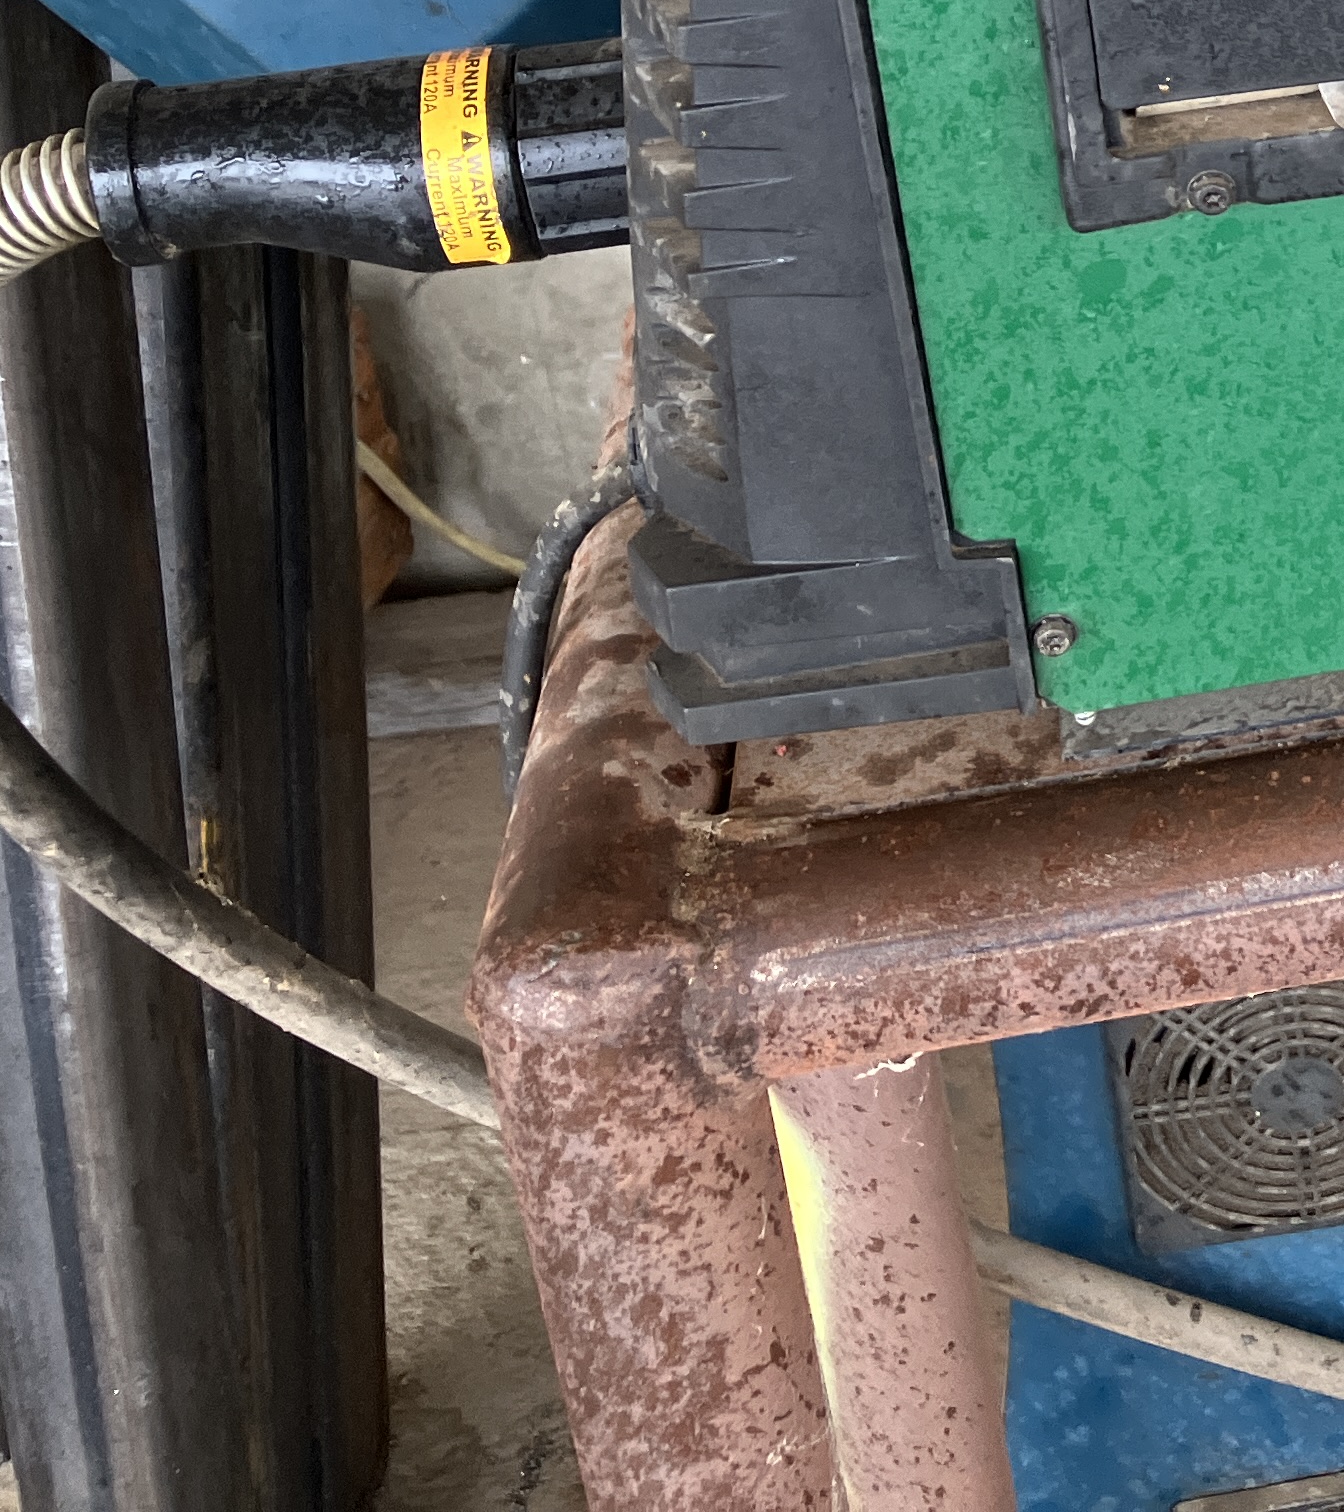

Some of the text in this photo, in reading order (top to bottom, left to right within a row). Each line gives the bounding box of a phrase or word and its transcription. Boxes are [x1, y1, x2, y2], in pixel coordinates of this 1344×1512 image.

[423, 80, 438, 115] 120A
[427, 149, 461, 252] Current 120A
[467, 154, 502, 251] WARNING
